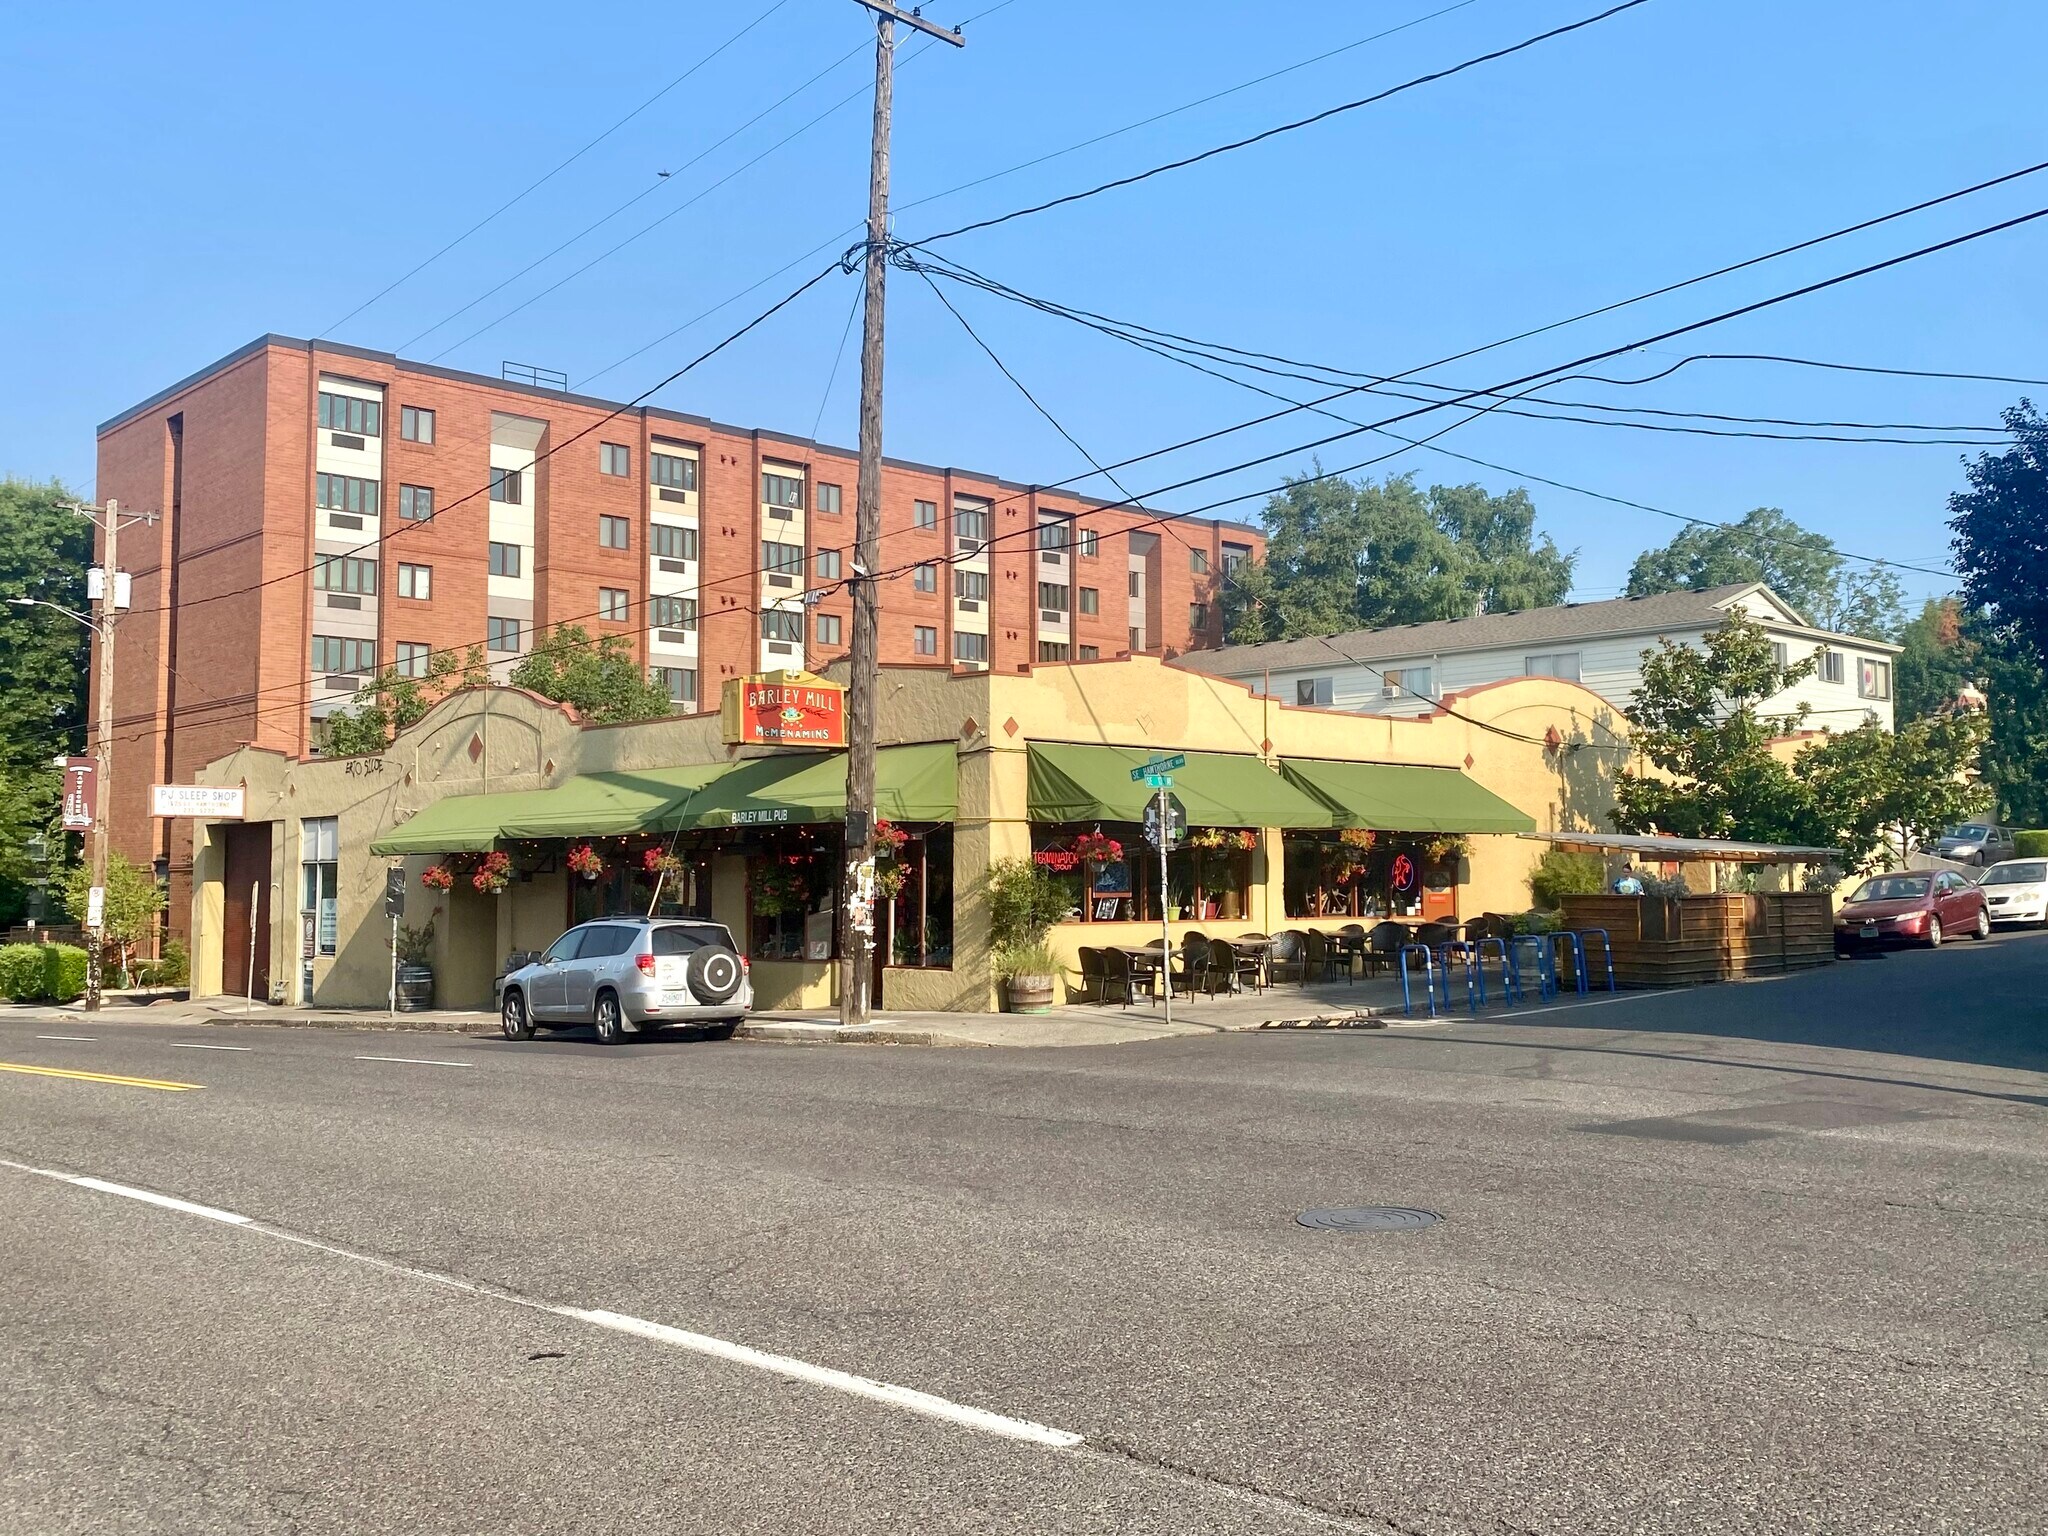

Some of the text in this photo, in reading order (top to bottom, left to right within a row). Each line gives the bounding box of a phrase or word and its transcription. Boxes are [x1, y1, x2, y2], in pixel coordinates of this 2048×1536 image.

[749, 688, 835, 712] BARLEY MILL
[1131, 769, 1140, 780] SE
[1142, 759, 1175, 775] HAWTHORNE
[1146, 776, 1154, 786] SE
[160, 790, 237, 801] PJ SLEEP SHOP
[731, 809, 788, 824] BARLEY MILL PUB
